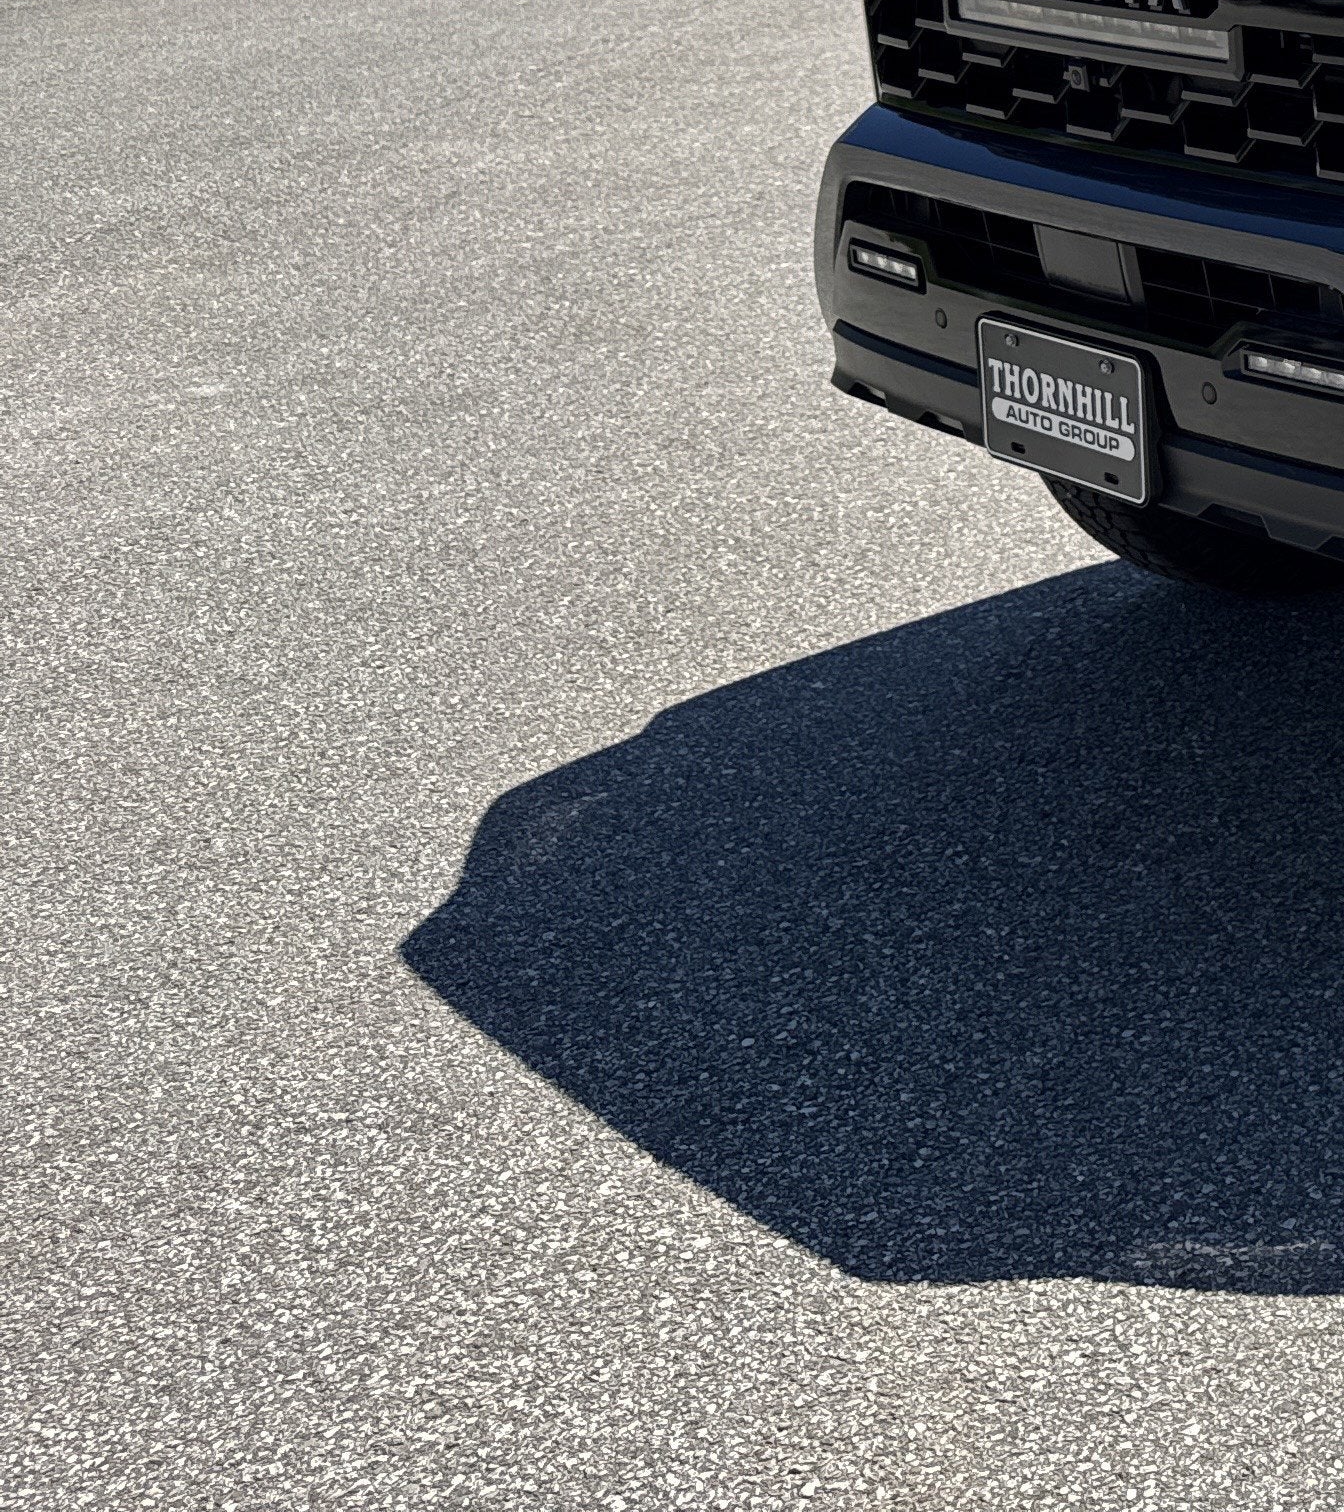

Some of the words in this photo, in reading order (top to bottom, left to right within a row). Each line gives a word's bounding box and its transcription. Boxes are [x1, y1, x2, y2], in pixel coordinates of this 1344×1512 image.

[988, 358, 1135, 434] THORNHILL
[1006, 405, 1053, 431] AUTO
[1059, 421, 1120, 451] GROUP
